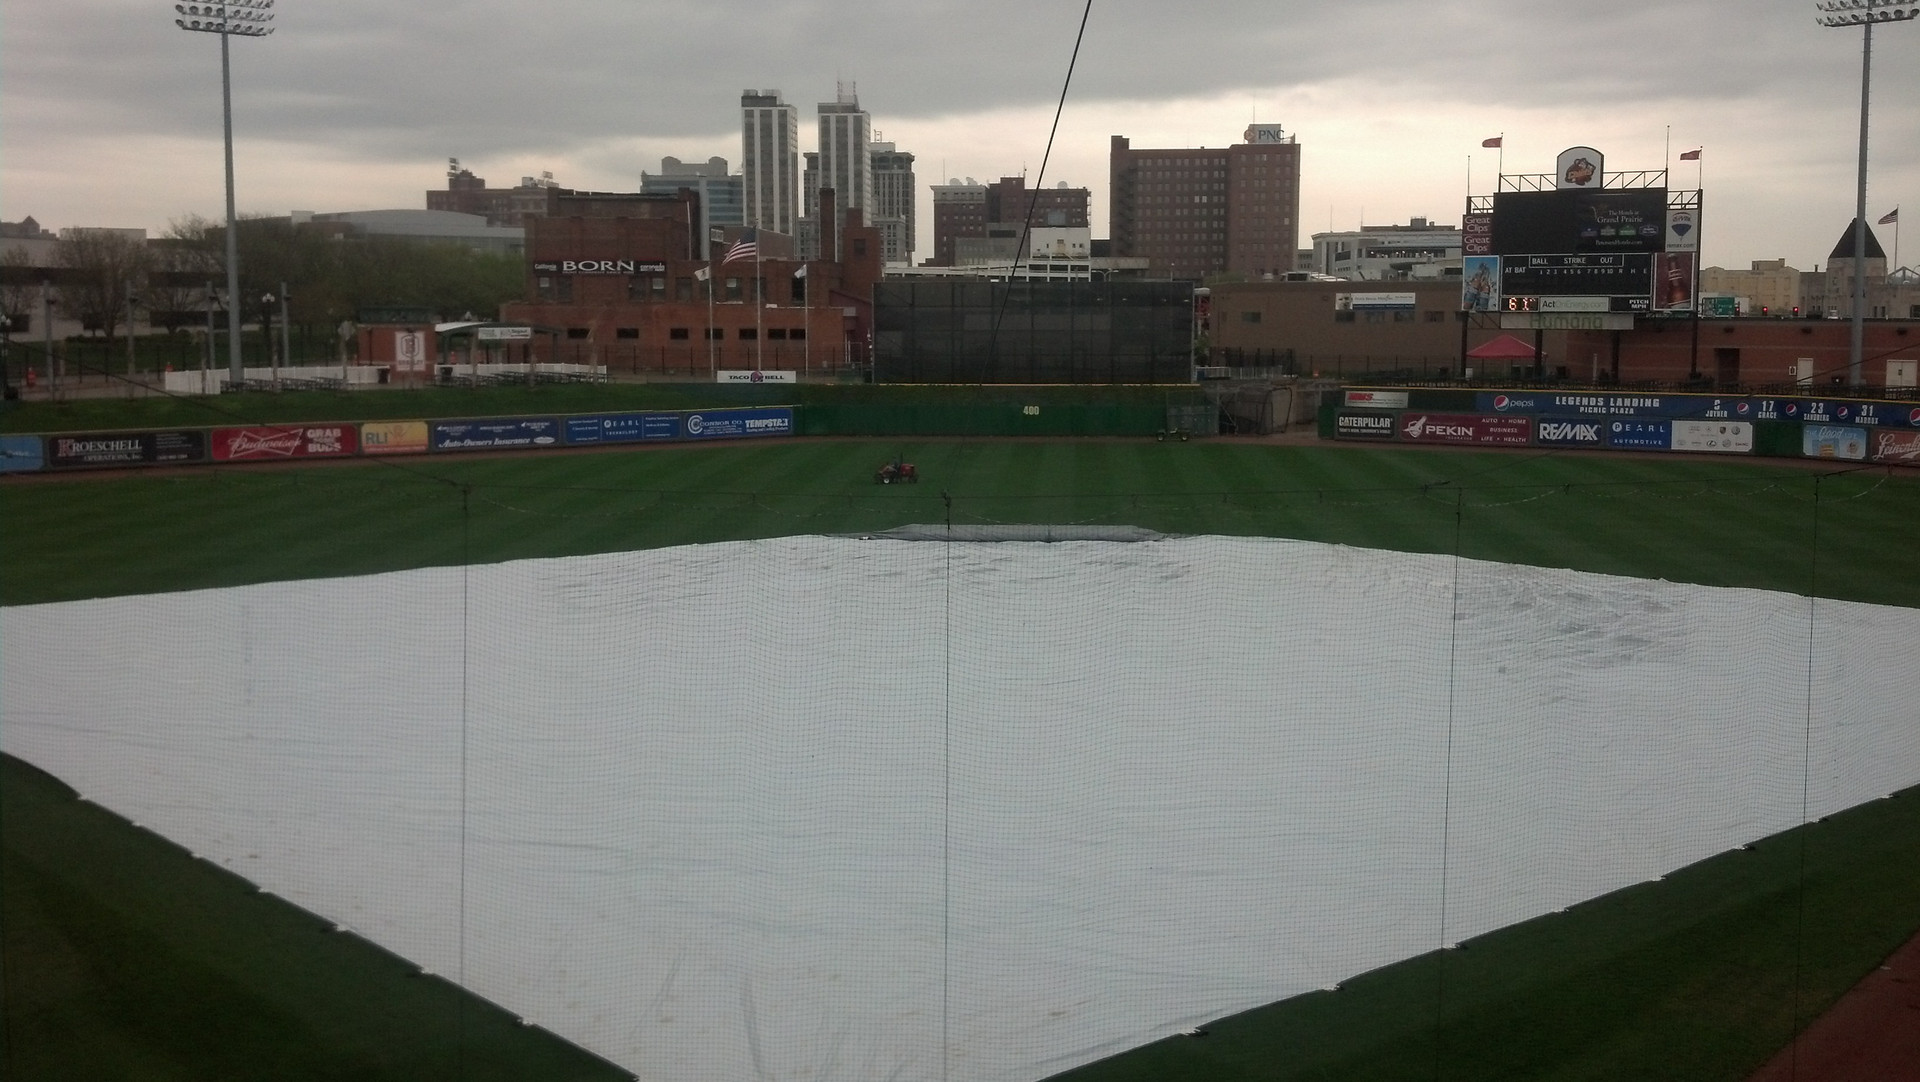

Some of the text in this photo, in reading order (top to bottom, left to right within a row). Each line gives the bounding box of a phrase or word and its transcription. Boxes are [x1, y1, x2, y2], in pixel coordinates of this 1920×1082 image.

[1258, 129, 1285, 140] PNC
[1467, 224, 1488, 233] Clips
[1466, 244, 1488, 253] Clips
[563, 260, 634, 271] BORN
[1510, 399, 1534, 407] pepsi
[1555, 396, 1660, 408] LEGENDS LANDING
[1762, 401, 1774, 411] 17
[1023, 406, 1039, 415] 400
[1610, 407, 1635, 415] PLAZA
[1811, 402, 1823, 414] 23
[1861, 405, 1873, 415] 31
[1758, 411, 1777, 419] GRACE
[1339, 417, 1391, 427] CATERPILLAR
[307, 429, 341, 438] GRAB
[1426, 425, 1473, 436] PEKIN
[1539, 422, 1600, 441] RE/MAX
[229, 437, 302, 451] Budweiser
[1613, 438, 1663, 446] AUTOMOTIVE
[57, 439, 142, 457] KROESCHELL
[308, 443, 341, 452] BUDS
